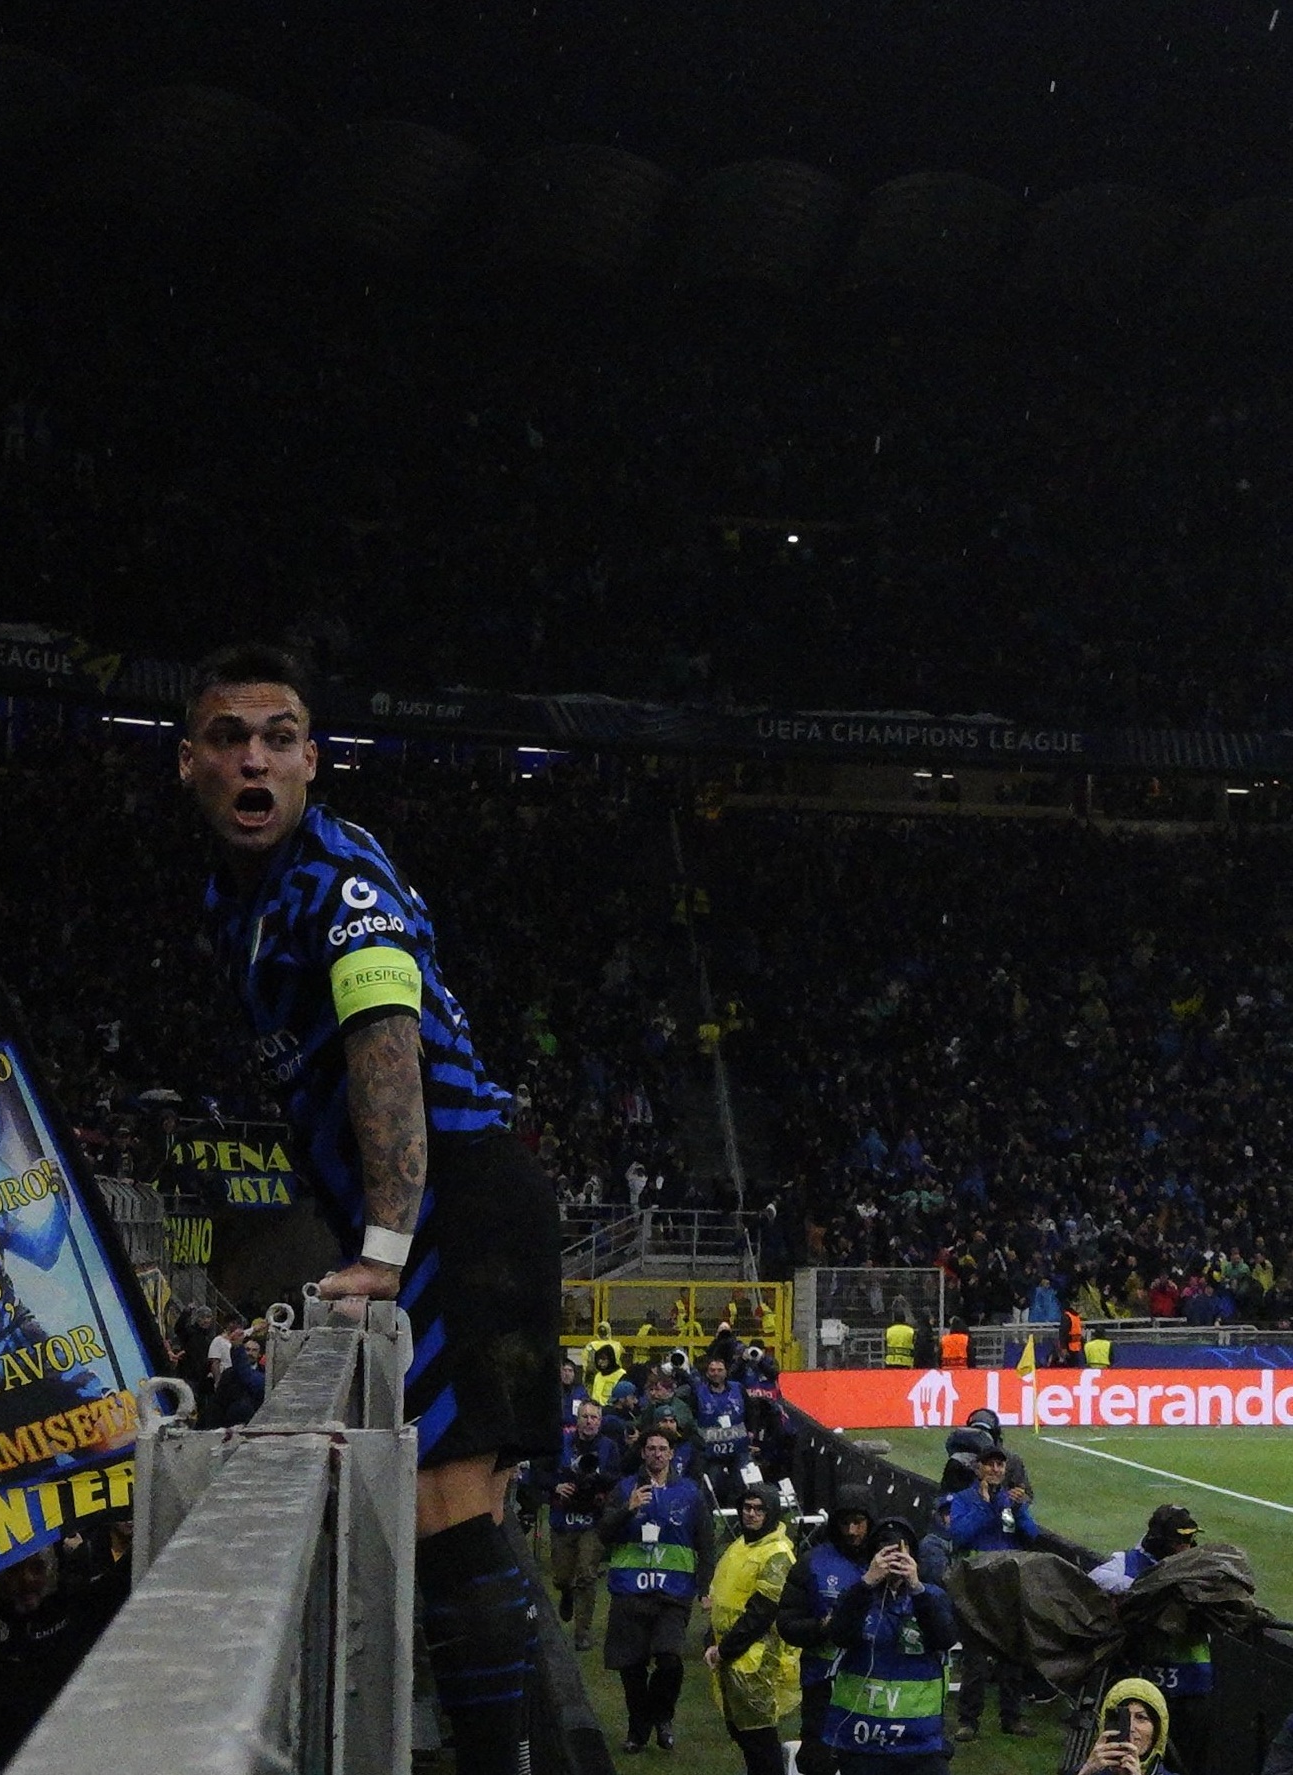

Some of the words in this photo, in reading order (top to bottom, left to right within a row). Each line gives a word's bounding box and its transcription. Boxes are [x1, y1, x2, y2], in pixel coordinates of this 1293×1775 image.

[395, 700, 433, 717] JUST
[435, 703, 465, 718] EAT
[757, 718, 823, 740] UEFA
[831, 721, 979, 748] CHAMPIONS
[989, 729, 1083, 752] LEAGUE
[328, 912, 404, 946] Gate.io
[356, 969, 412, 985] RESPECT
[713, 1441, 735, 1454] 022
[640, 1546, 667, 1565] TV
[636, 1572, 667, 1590] 017
[865, 1684, 902, 1712] TV
[853, 1720, 906, 1747] 047
